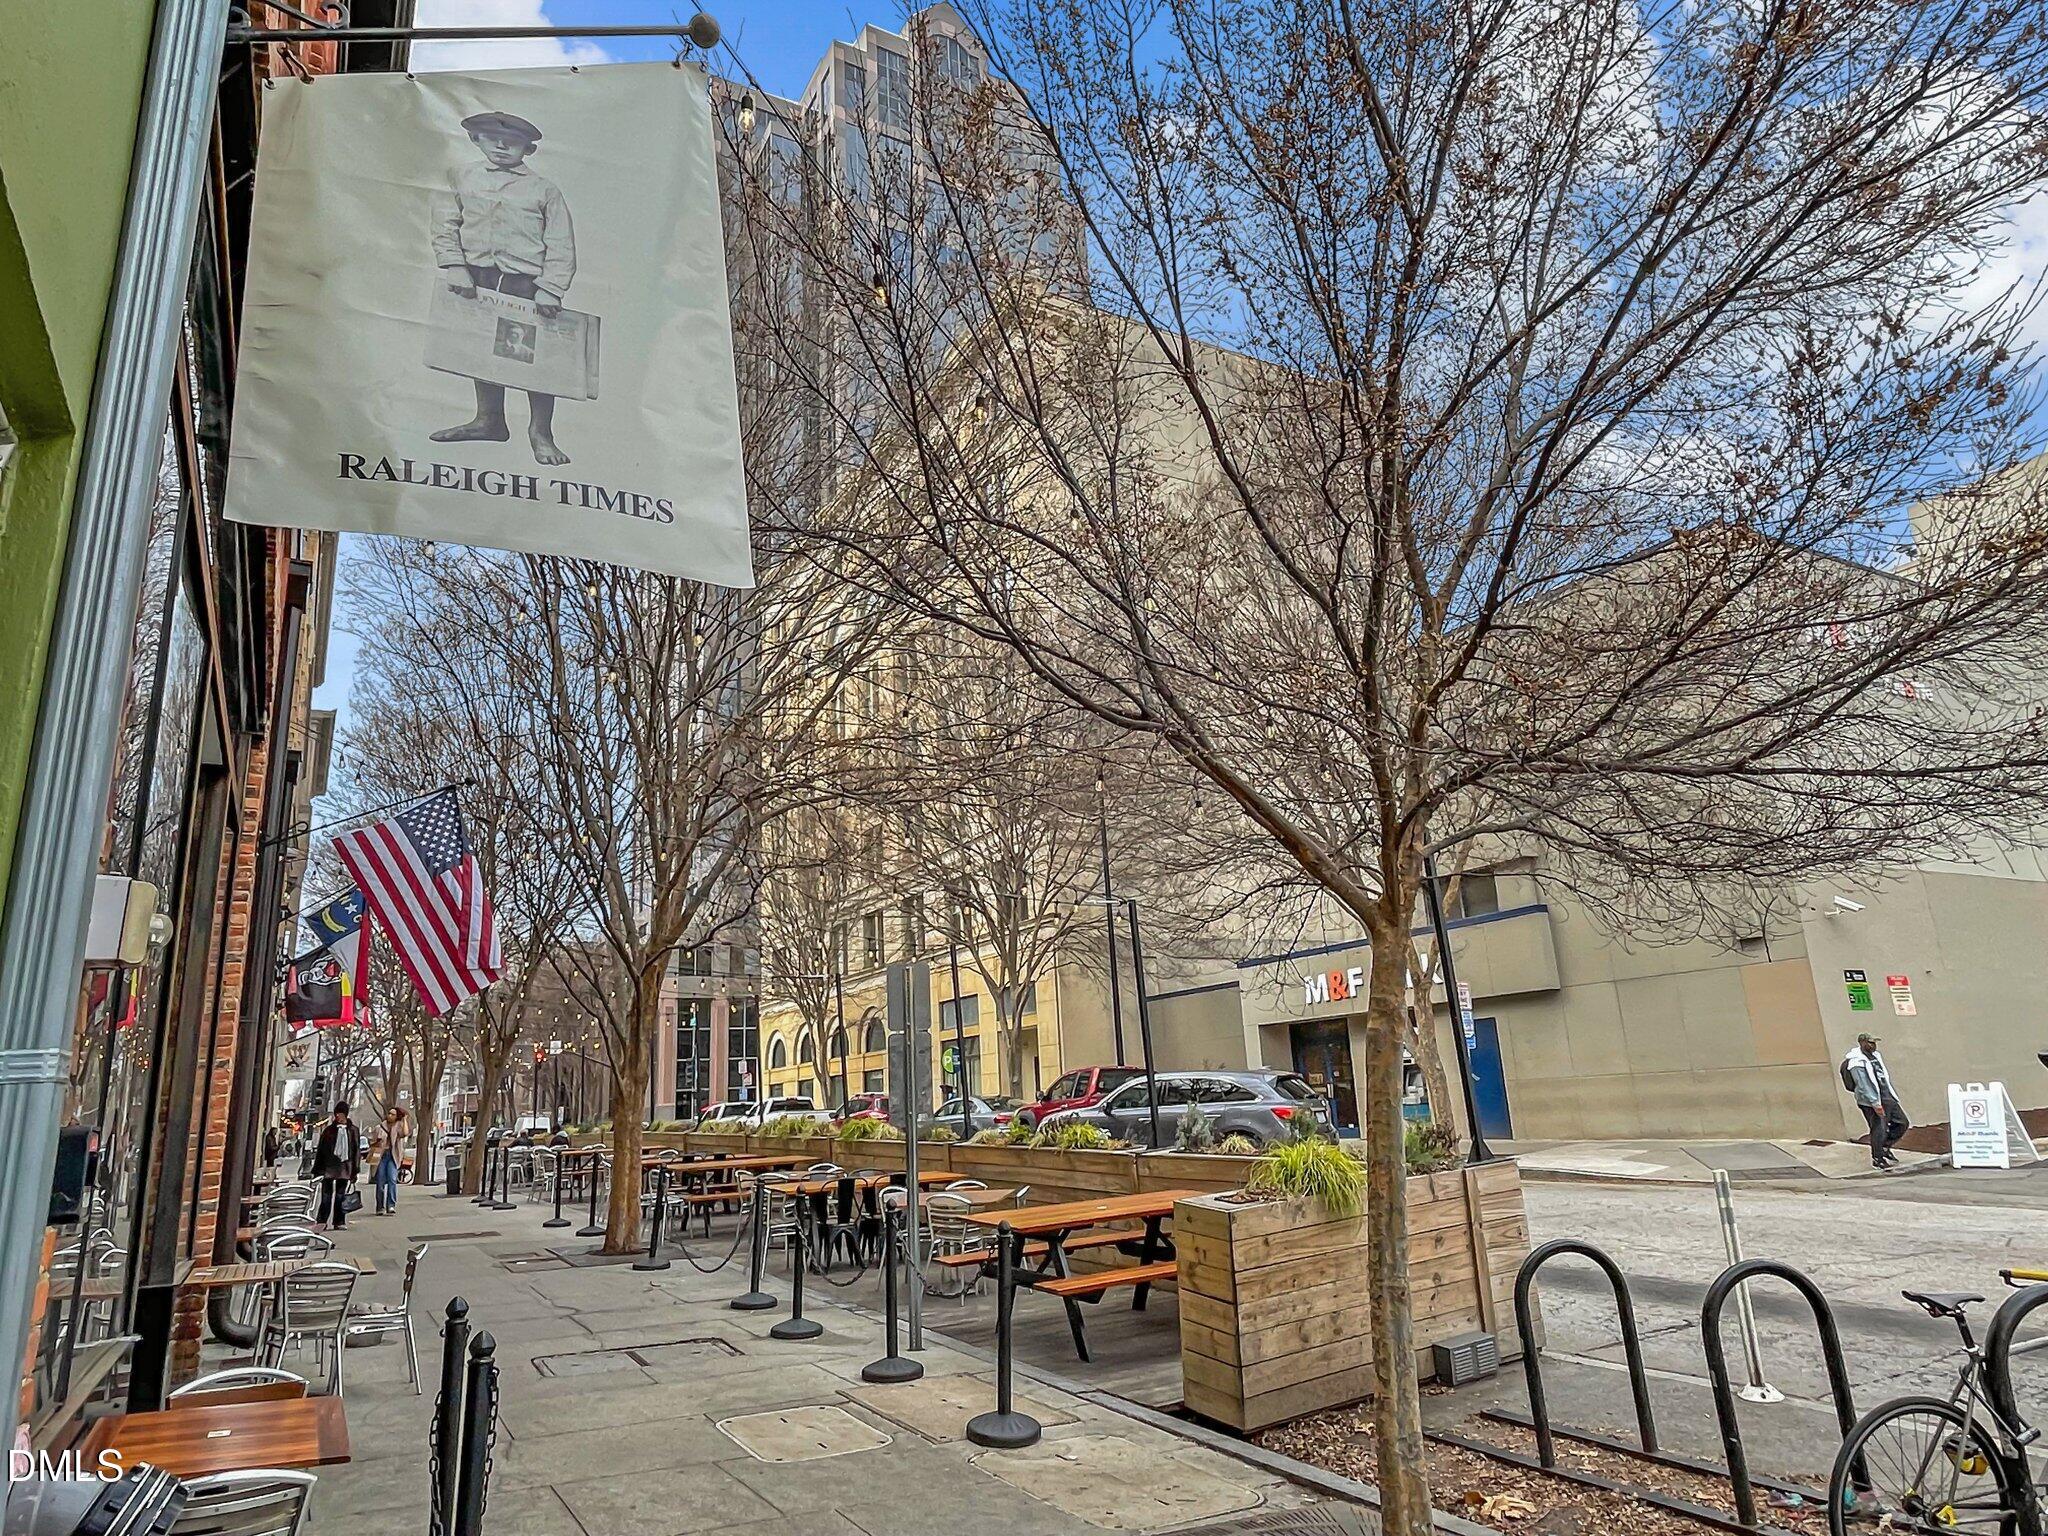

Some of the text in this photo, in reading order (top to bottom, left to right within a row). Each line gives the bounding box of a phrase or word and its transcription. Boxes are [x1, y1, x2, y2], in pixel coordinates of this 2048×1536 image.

[337, 452, 676, 525] RALEIGH TIMES
[1304, 966, 1365, 1005] M&F
